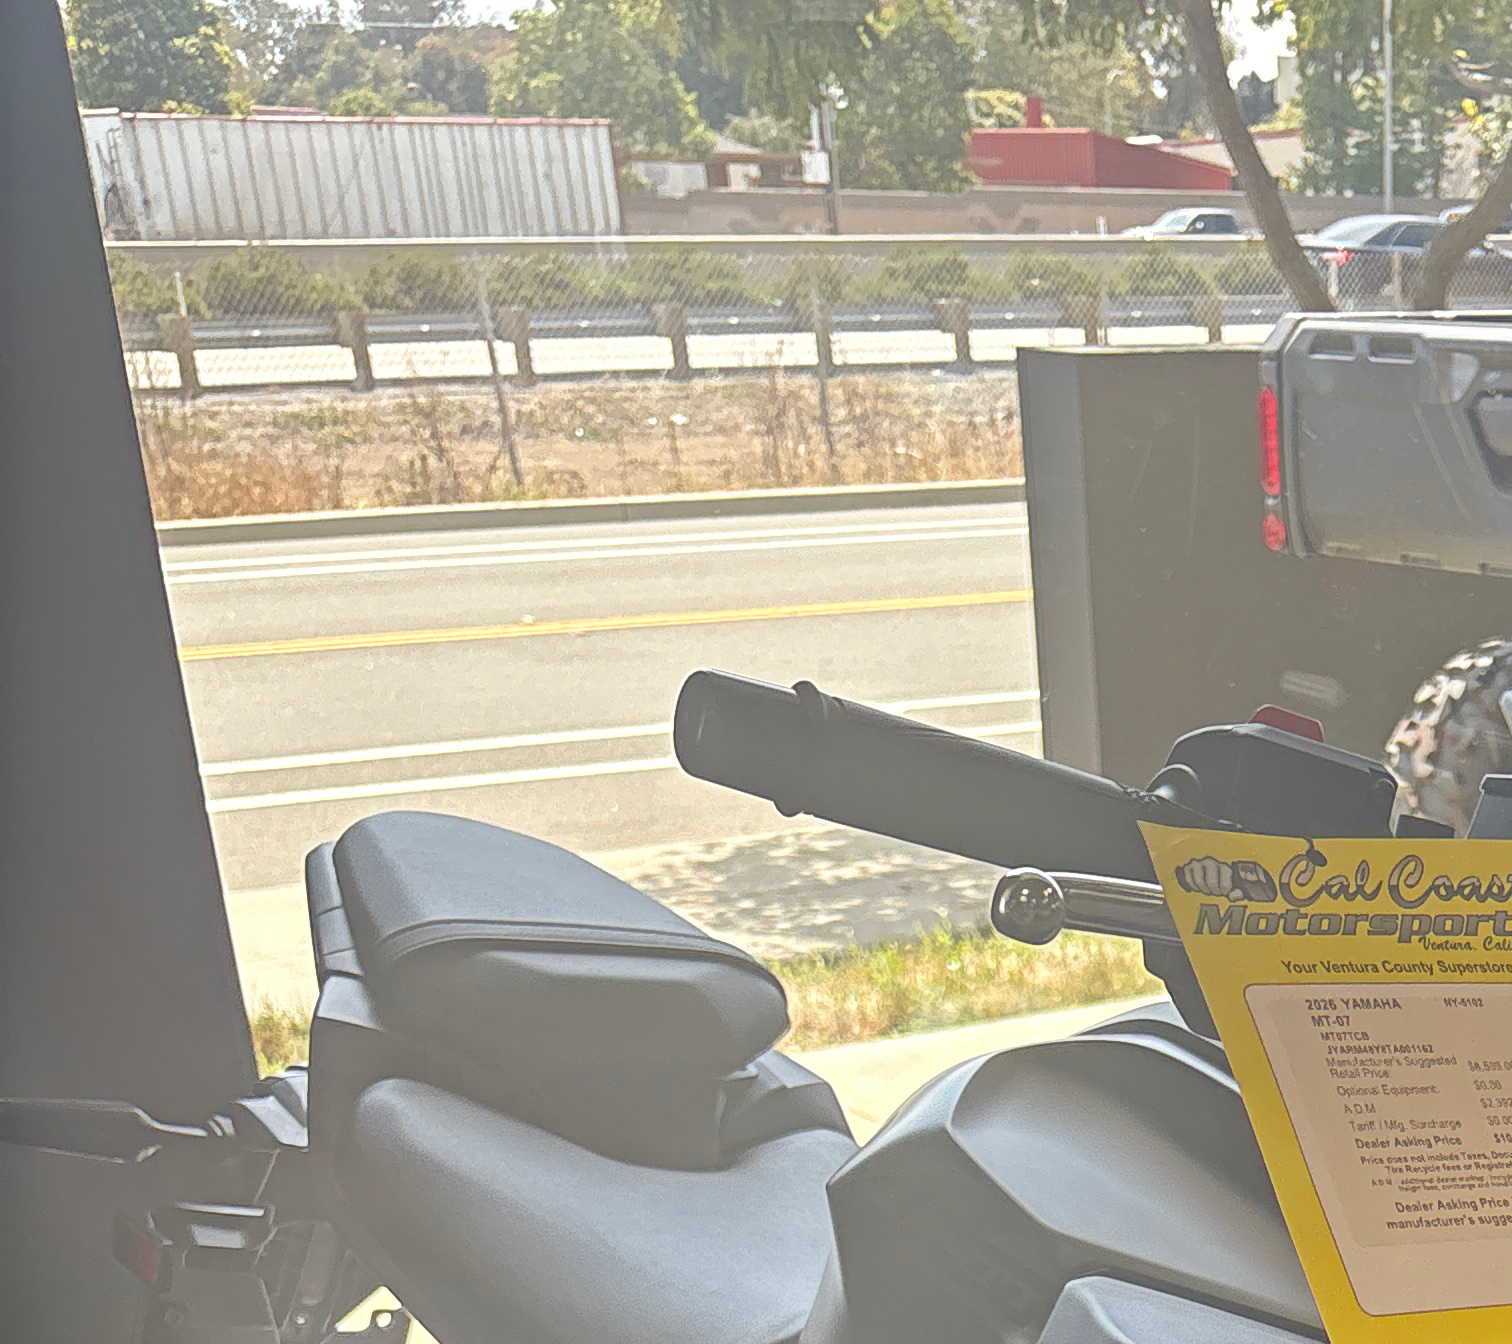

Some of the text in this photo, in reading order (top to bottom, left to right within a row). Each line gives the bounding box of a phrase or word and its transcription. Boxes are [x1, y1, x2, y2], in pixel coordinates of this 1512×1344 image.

[1279, 854, 1383, 907] Cal
[1281, 960, 1317, 974] Your
[1320, 960, 1379, 974] Ventura
[1381, 960, 1434, 976] County
[1305, 998, 1402, 1011] 2026 YAMAHA
[1311, 1015, 1350, 1027] MT-07
[1354, 1134, 1463, 1150] Dealer Asking Price
[1395, 1200, 1434, 1213] Dealer
[1437, 1198, 1478, 1212] Asking
[1479, 1197, 1509, 1209] Price
[1386, 1213, 1475, 1230] manufacturer's
